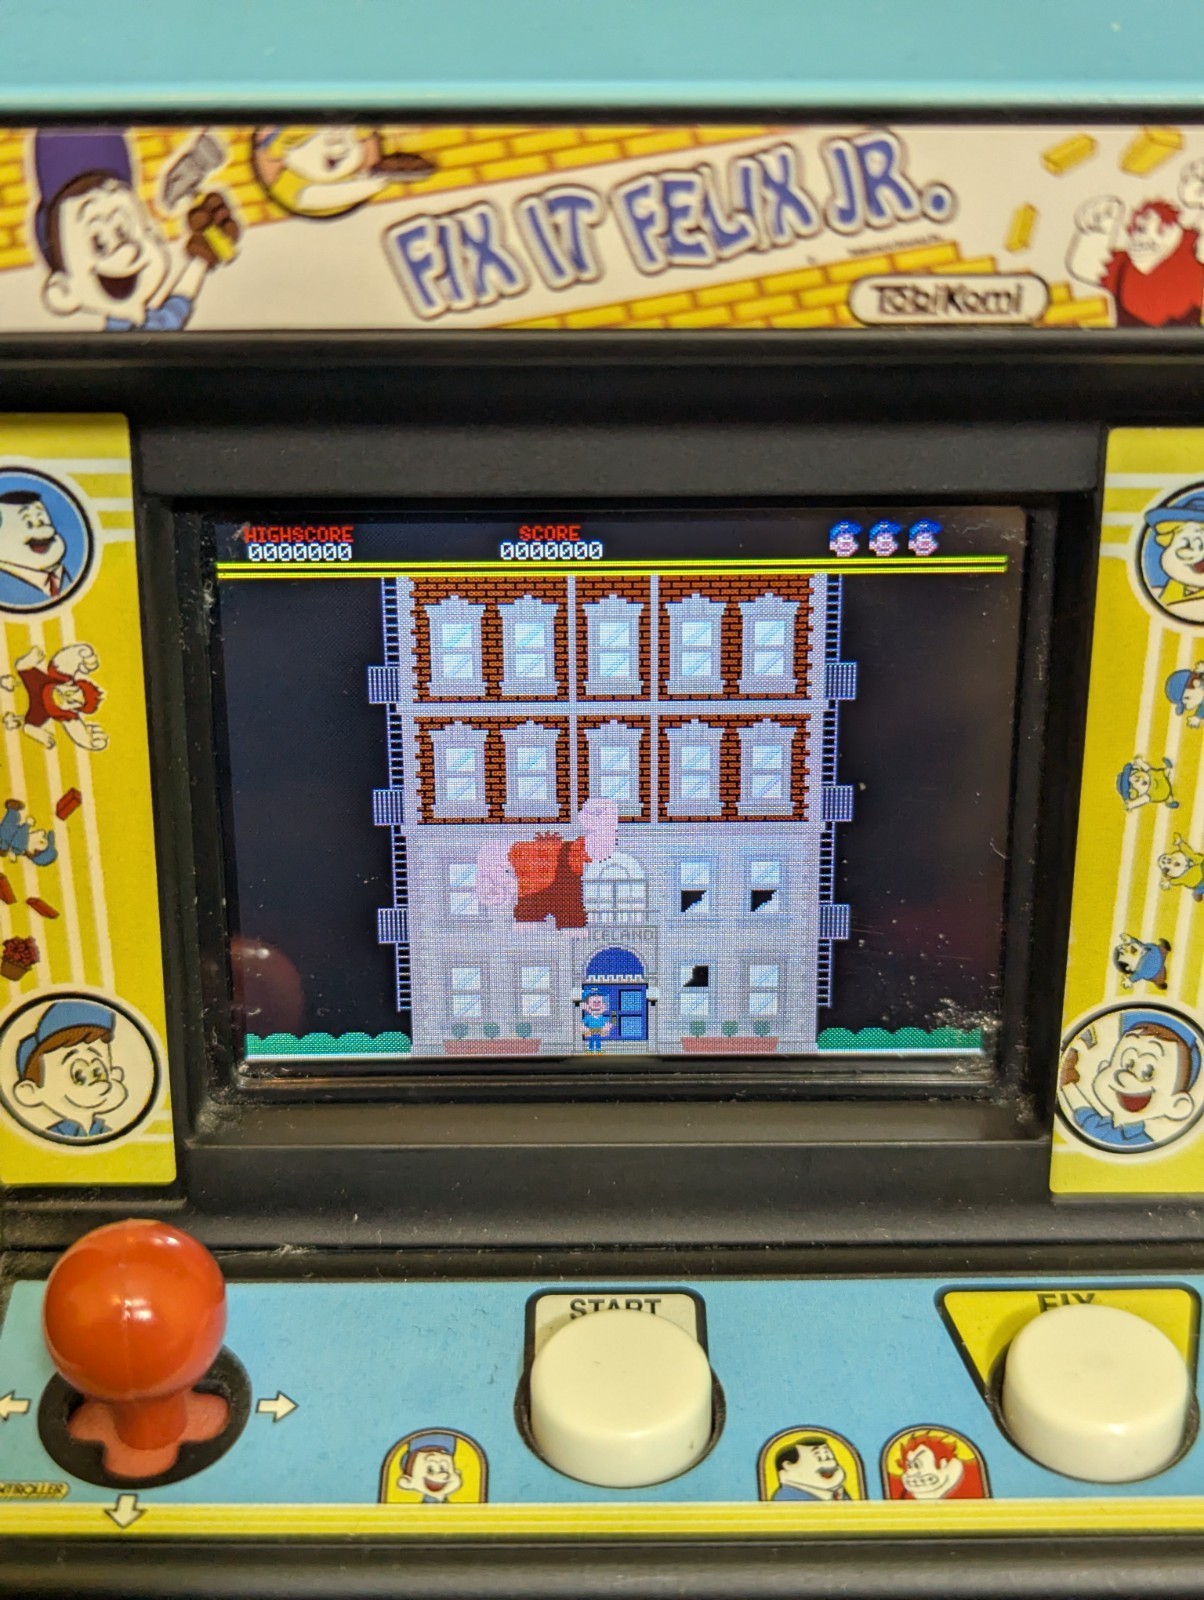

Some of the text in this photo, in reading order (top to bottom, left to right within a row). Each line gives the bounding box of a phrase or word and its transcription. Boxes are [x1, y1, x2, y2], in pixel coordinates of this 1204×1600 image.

[385, 131, 955, 318] FIX IT FELIX JR.
[243, 525, 354, 543] HIGHSCORE
[519, 525, 581, 542] SCORE
[248, 543, 353, 562] 0000000
[500, 541, 604, 560] 0000000
